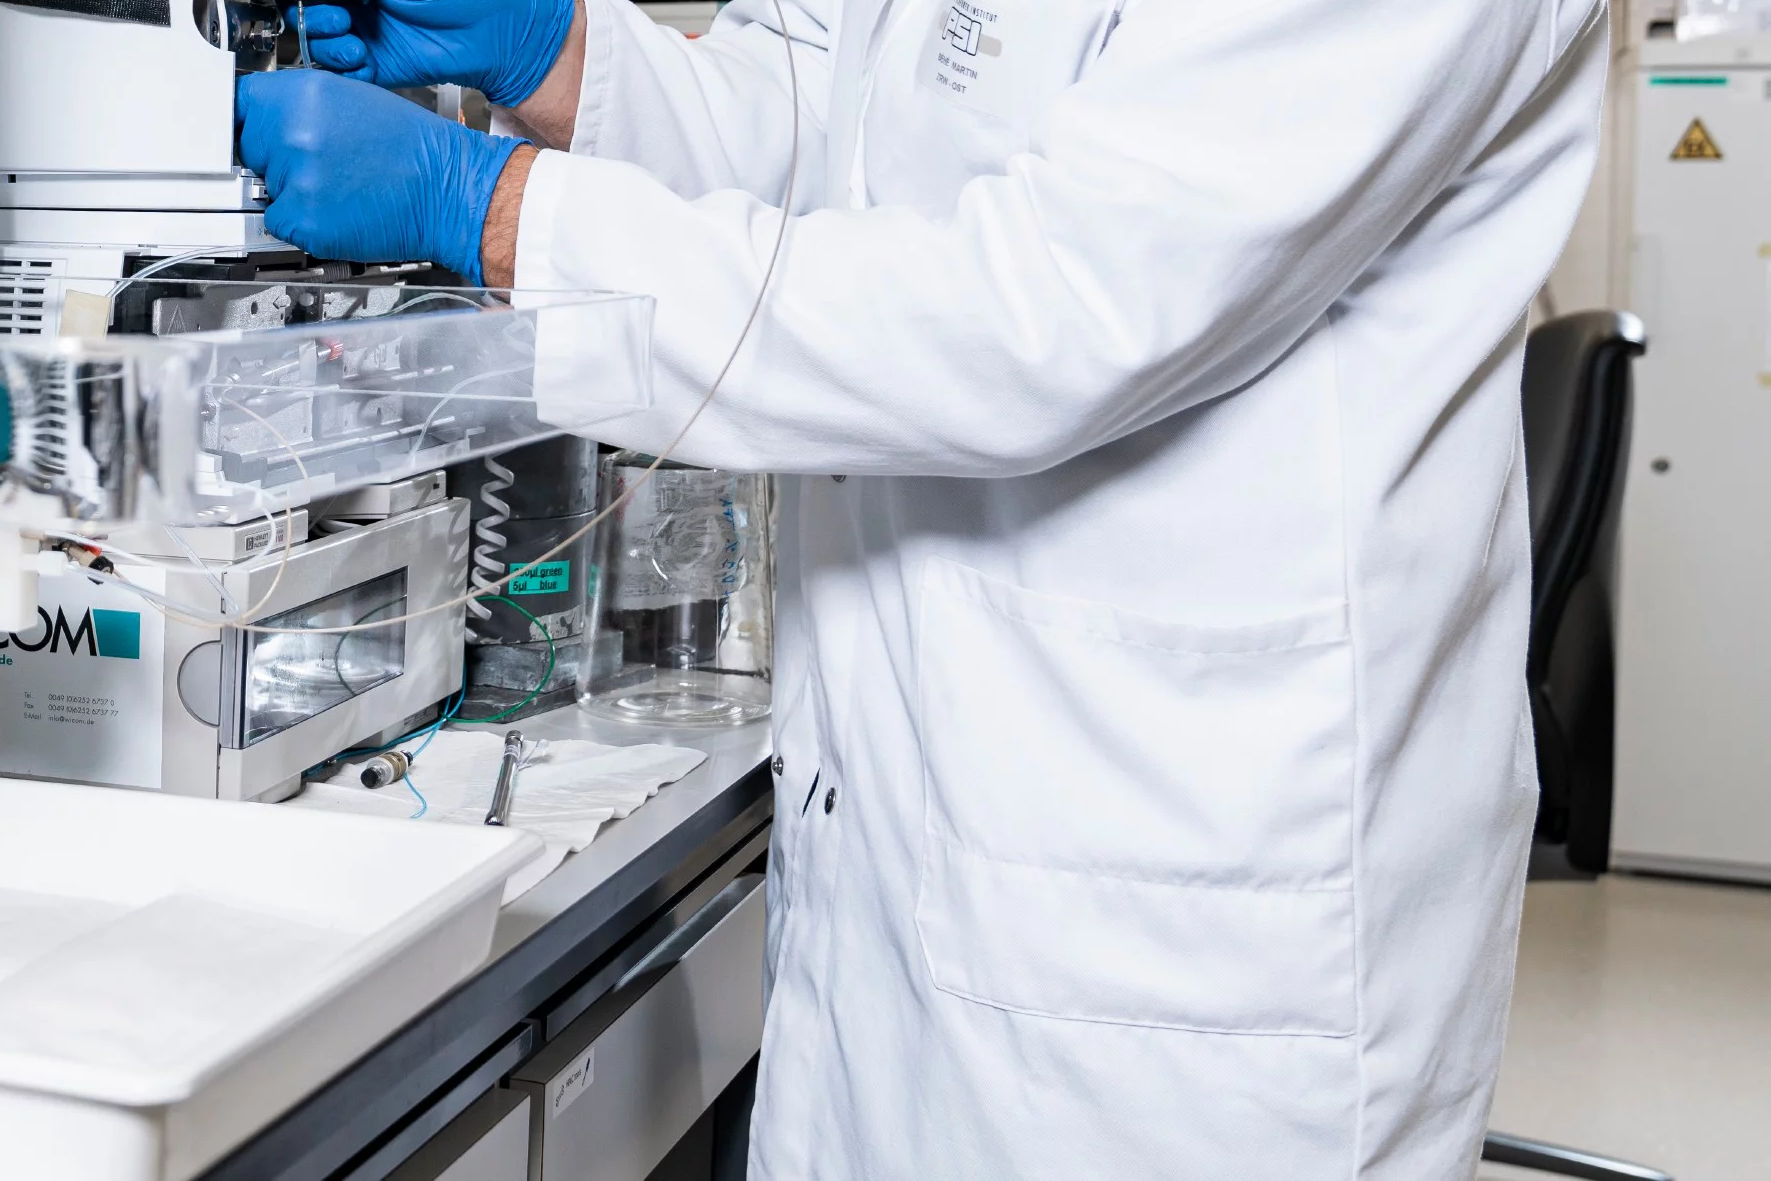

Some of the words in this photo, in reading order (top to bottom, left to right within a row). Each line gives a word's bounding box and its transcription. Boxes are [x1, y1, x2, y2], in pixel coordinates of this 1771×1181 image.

[952, 60, 979, 80] MARTIN
[540, 567, 563, 579] green
[539, 579, 557, 590] blue
[48, 693, 65, 701] 0049
